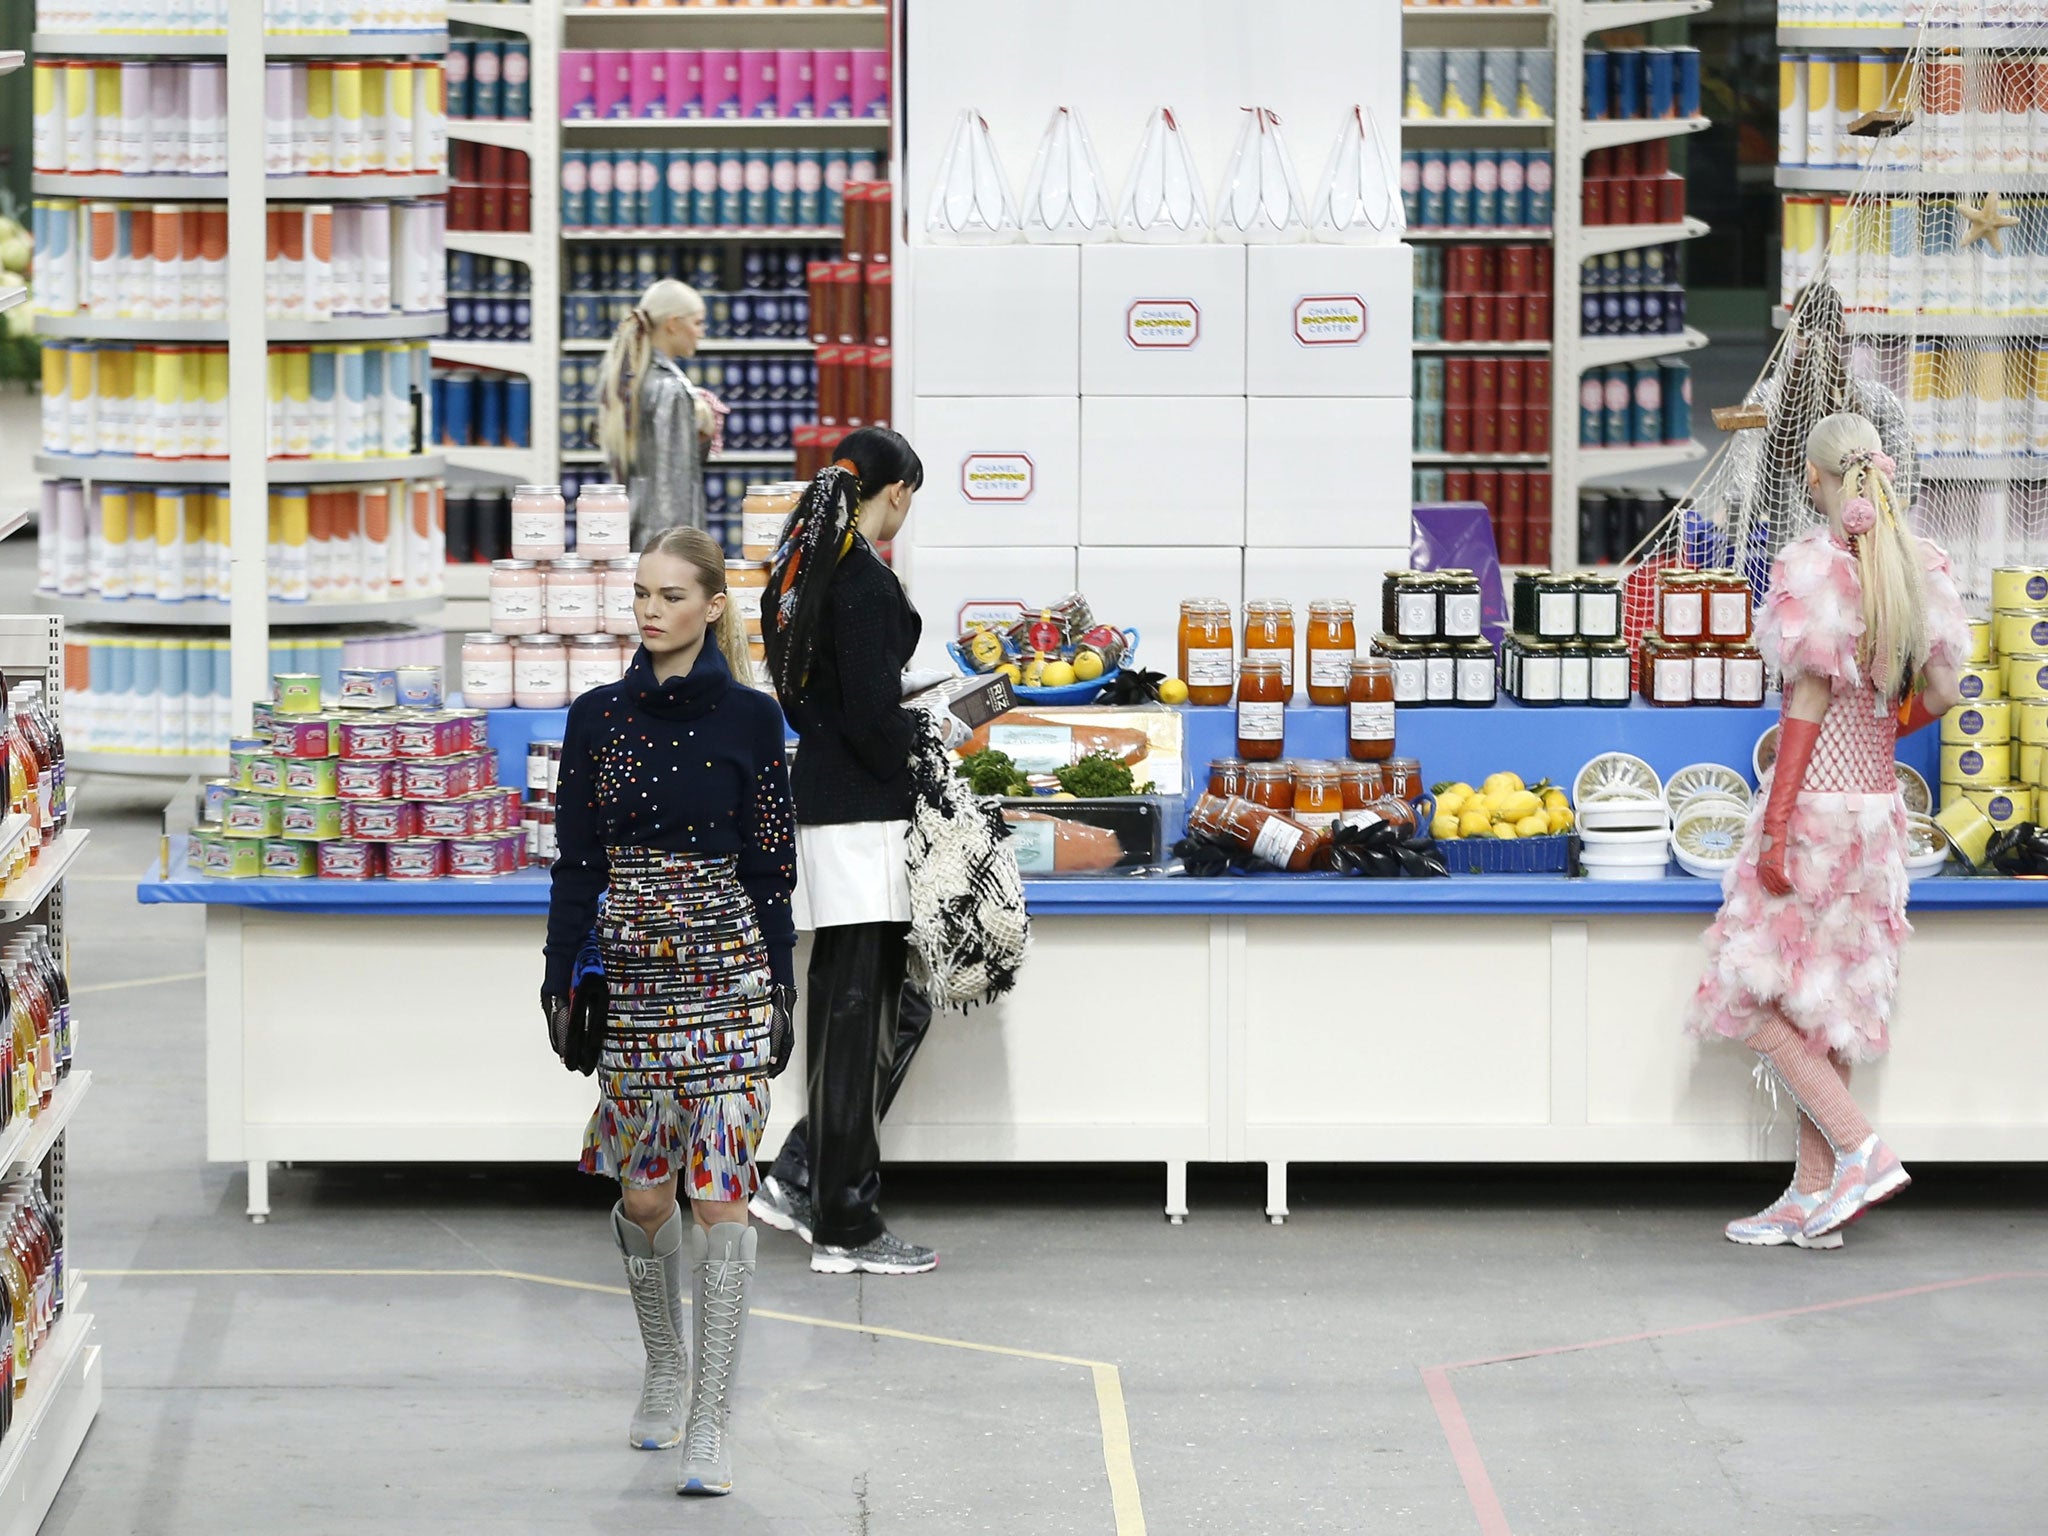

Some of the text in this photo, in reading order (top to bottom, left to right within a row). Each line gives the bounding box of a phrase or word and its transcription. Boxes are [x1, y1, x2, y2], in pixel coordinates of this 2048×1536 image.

[1141, 311, 1184, 319] CHANEL
[1308, 307, 1351, 316] CHANEL
[1134, 319, 1192, 328] SHOPPING
[1302, 315, 1358, 325] SHOPPING
[1141, 328, 1184, 336] CENTER
[1308, 324, 1352, 333] CENTER
[975, 464, 1019, 473] CHANEL
[969, 473, 1026, 481] SHOPPING
[975, 482, 1019, 490] CENTER
[993, 683, 1008, 711] RIZ
